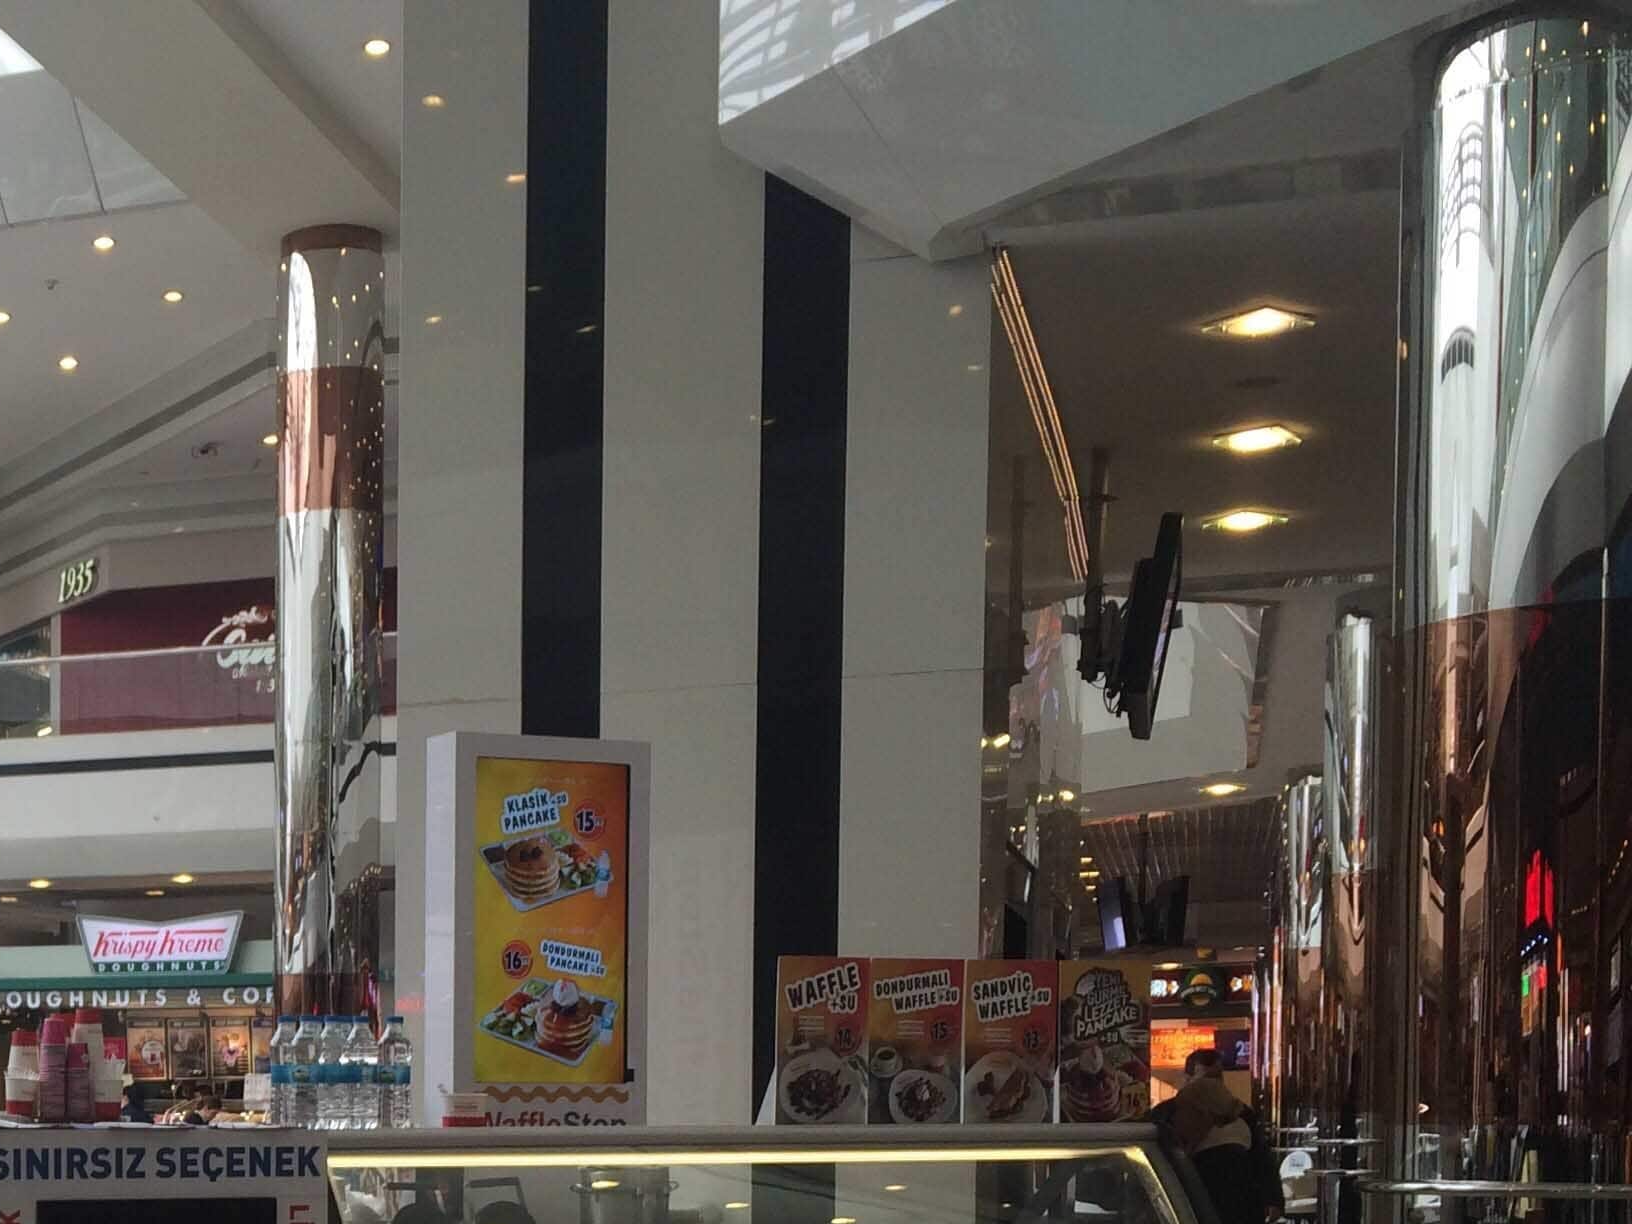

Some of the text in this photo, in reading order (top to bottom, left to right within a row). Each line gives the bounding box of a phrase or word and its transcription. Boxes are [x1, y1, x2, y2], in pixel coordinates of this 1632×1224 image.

[58, 558, 95, 603] 1935
[506, 792, 549, 813] KLASİK
[504, 808, 557, 831] PANCAKE
[93, 928, 227, 959] Krispy Kreme
[97, 961, 221, 973] DOUGHNUTS
[550, 956, 588, 973] PANCAKE
[787, 965, 859, 1008] WAFFLE
[876, 972, 949, 996] DONDURMALI
[187, 989, 201, 1005] &
[894, 994, 936, 1011] WAFFLE
[978, 1000, 1030, 1020] WAFFLE
[1076, 1008, 1137, 1038] PANCAKE
[155, 1146, 321, 1182] SEÇENEK
